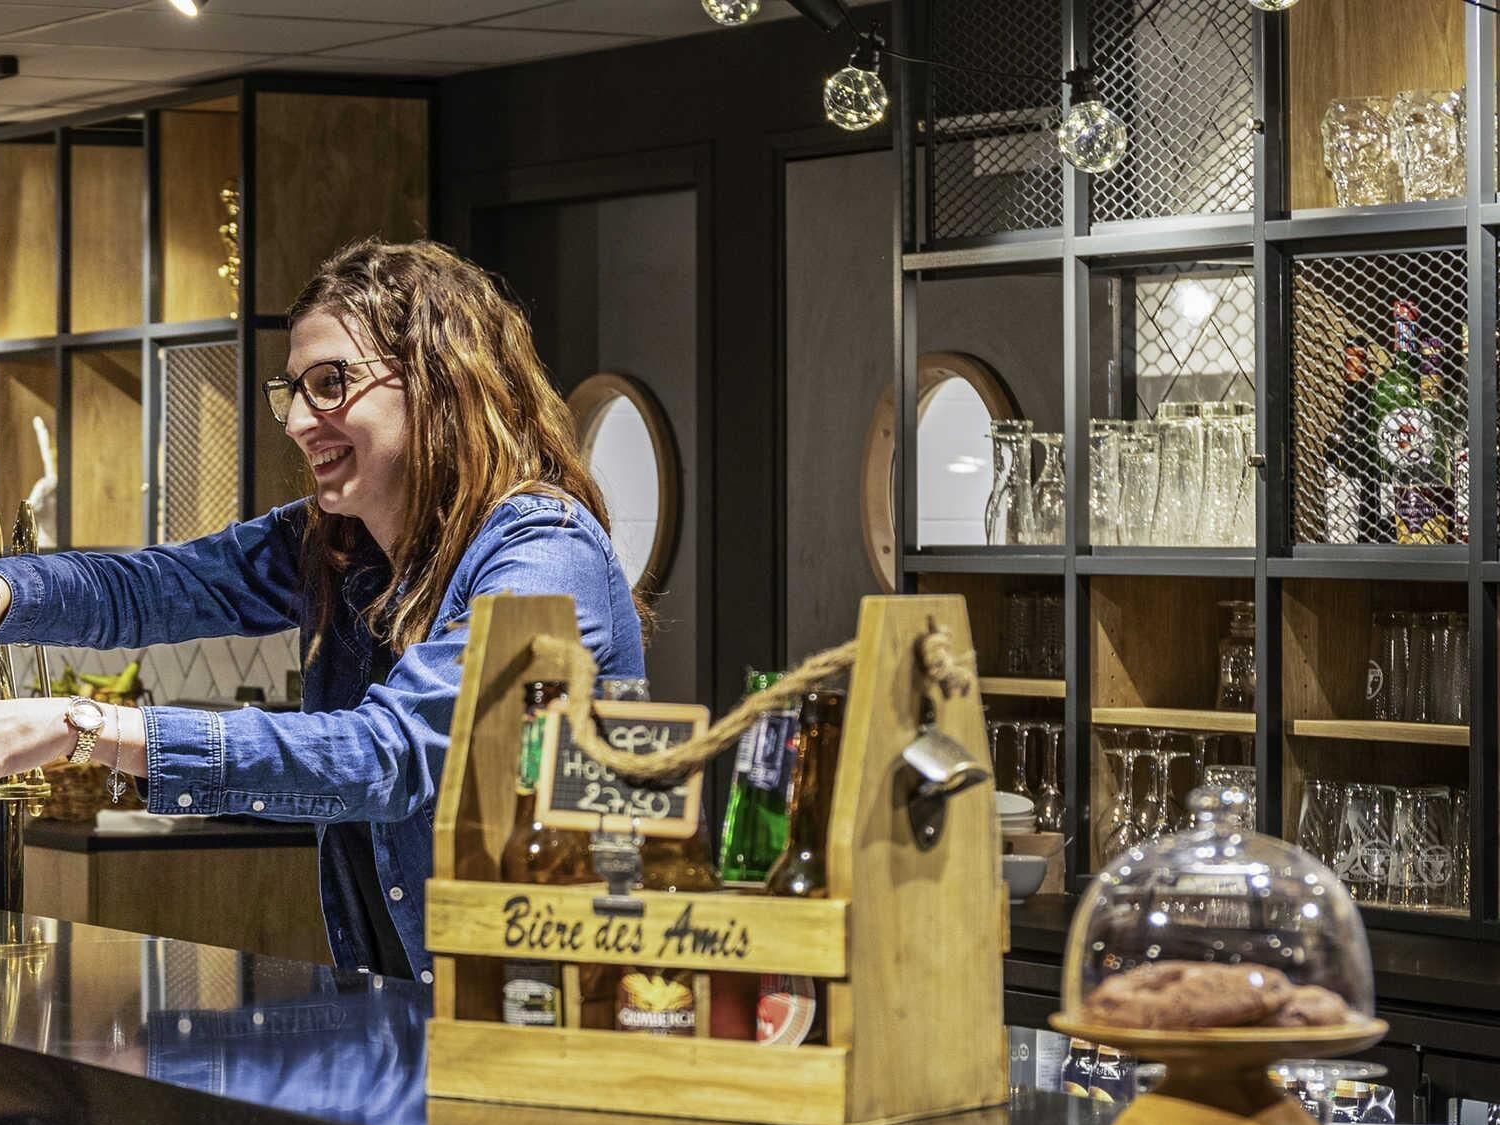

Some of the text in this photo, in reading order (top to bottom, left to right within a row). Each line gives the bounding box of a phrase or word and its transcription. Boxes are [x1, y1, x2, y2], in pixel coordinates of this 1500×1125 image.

[502, 895, 750, 960] Bière des Amis
